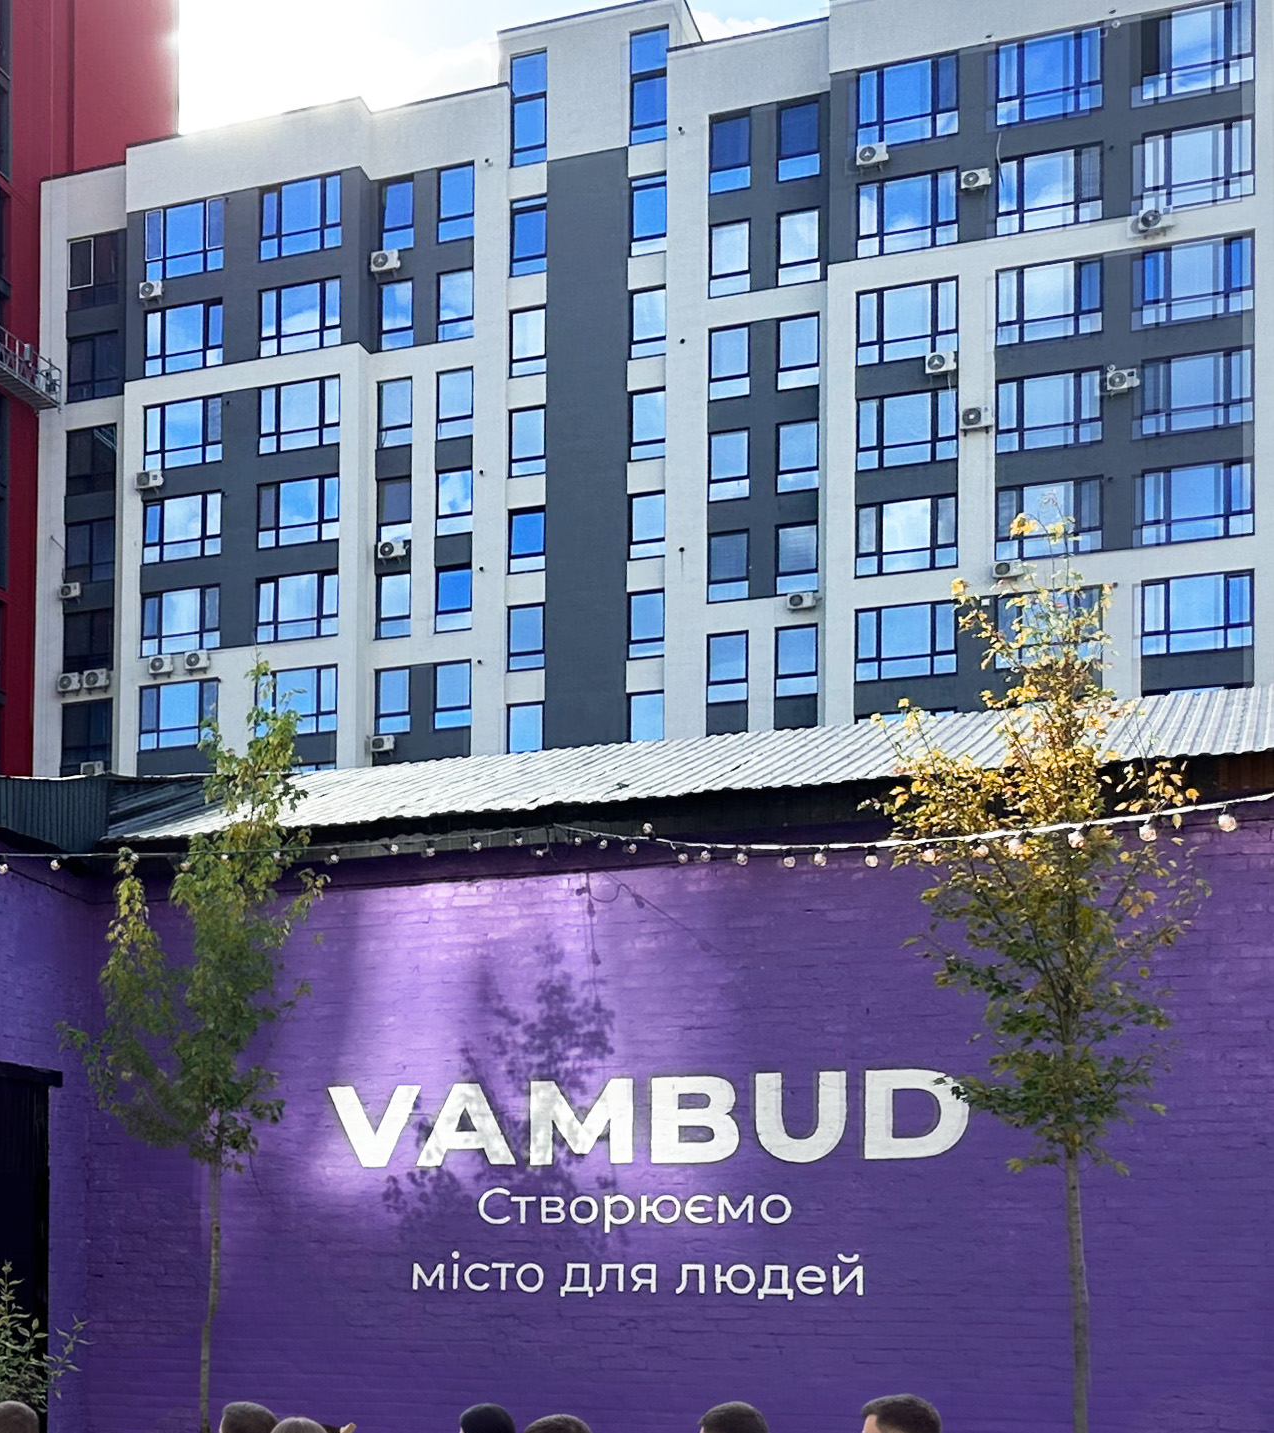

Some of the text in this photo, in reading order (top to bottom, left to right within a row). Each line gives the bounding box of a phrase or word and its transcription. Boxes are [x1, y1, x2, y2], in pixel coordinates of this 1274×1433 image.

[327, 1066, 970, 1169] VAMBUD
[477, 1186, 793, 1234] Створюємо
[411, 1250, 865, 1300] місто для людей
